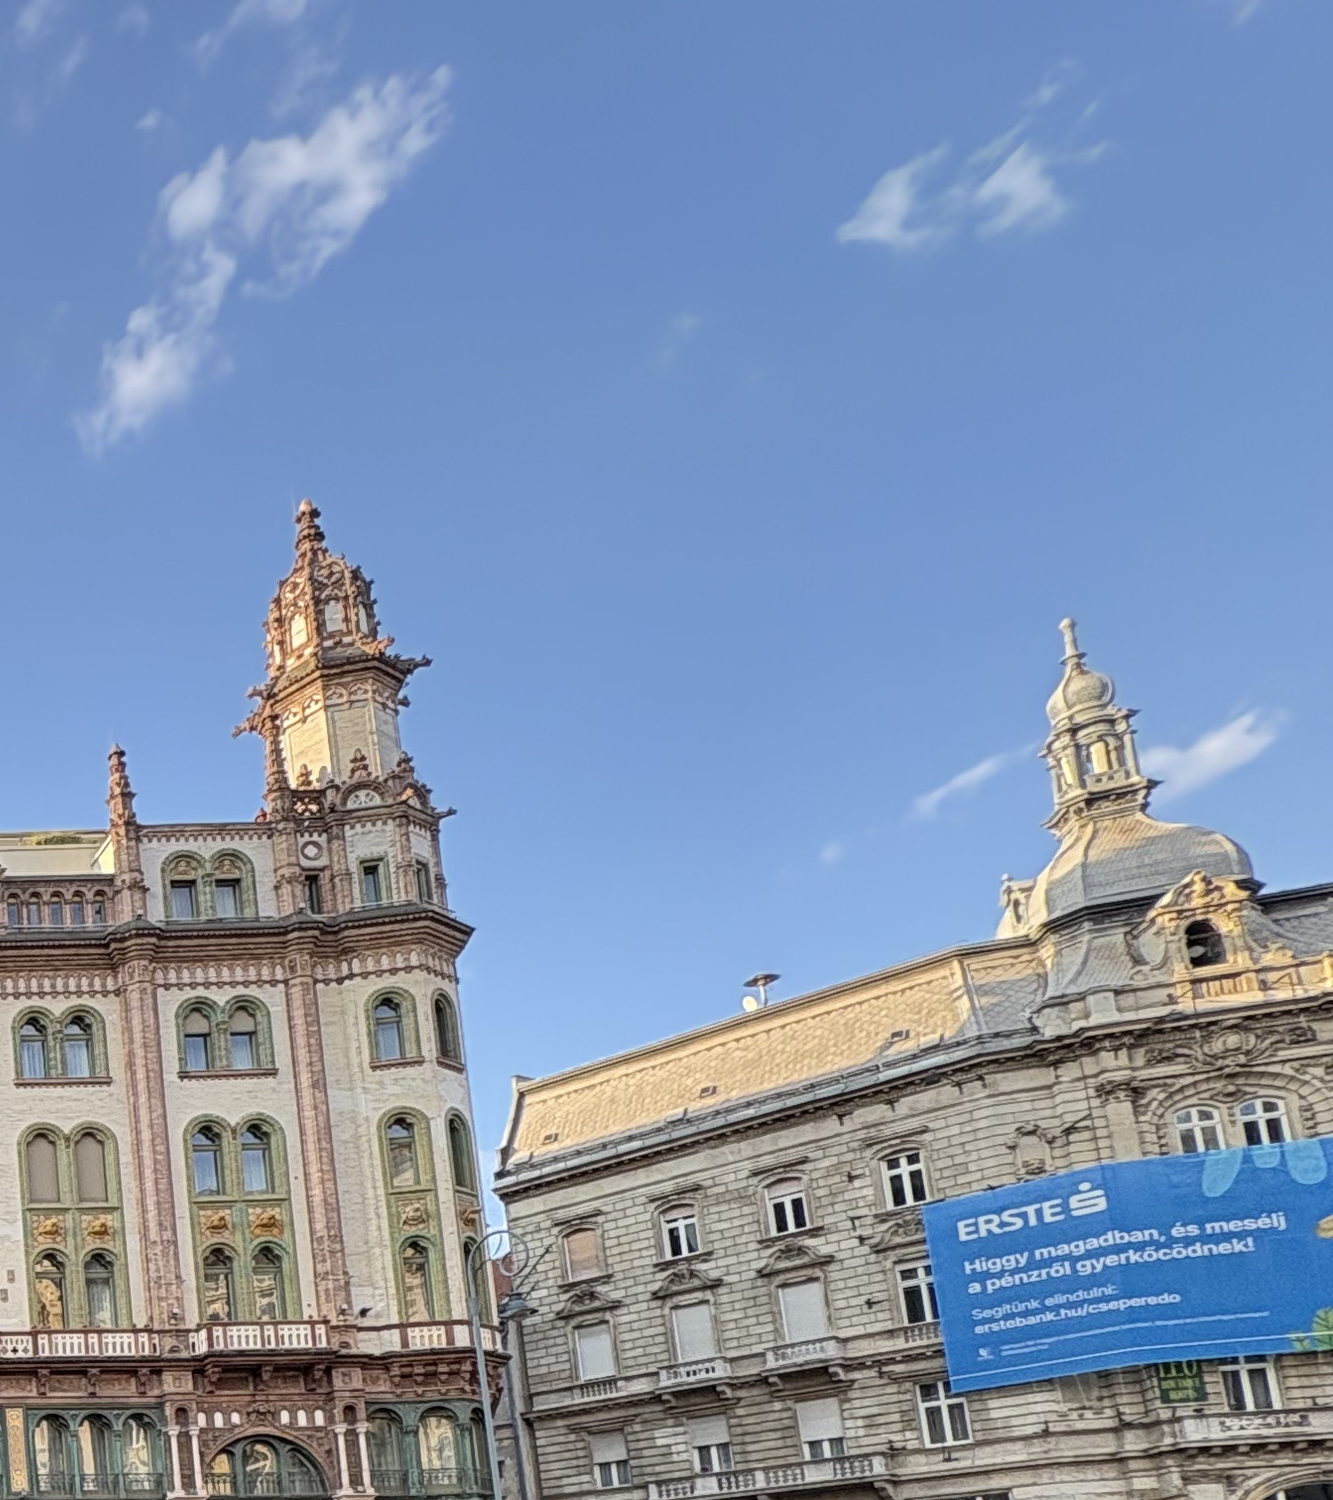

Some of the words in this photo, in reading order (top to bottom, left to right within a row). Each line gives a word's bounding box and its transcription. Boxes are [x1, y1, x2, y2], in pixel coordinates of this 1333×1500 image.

[956, 1198, 1065, 1242] ERSTE
[964, 1251, 1029, 1275] Higgy
[1034, 1229, 1167, 1261] magadban,
[1170, 1221, 1200, 1239] és
[1204, 1211, 1287, 1234] mesélj
[967, 1281, 982, 1295] a
[986, 1262, 1072, 1294] pénzről
